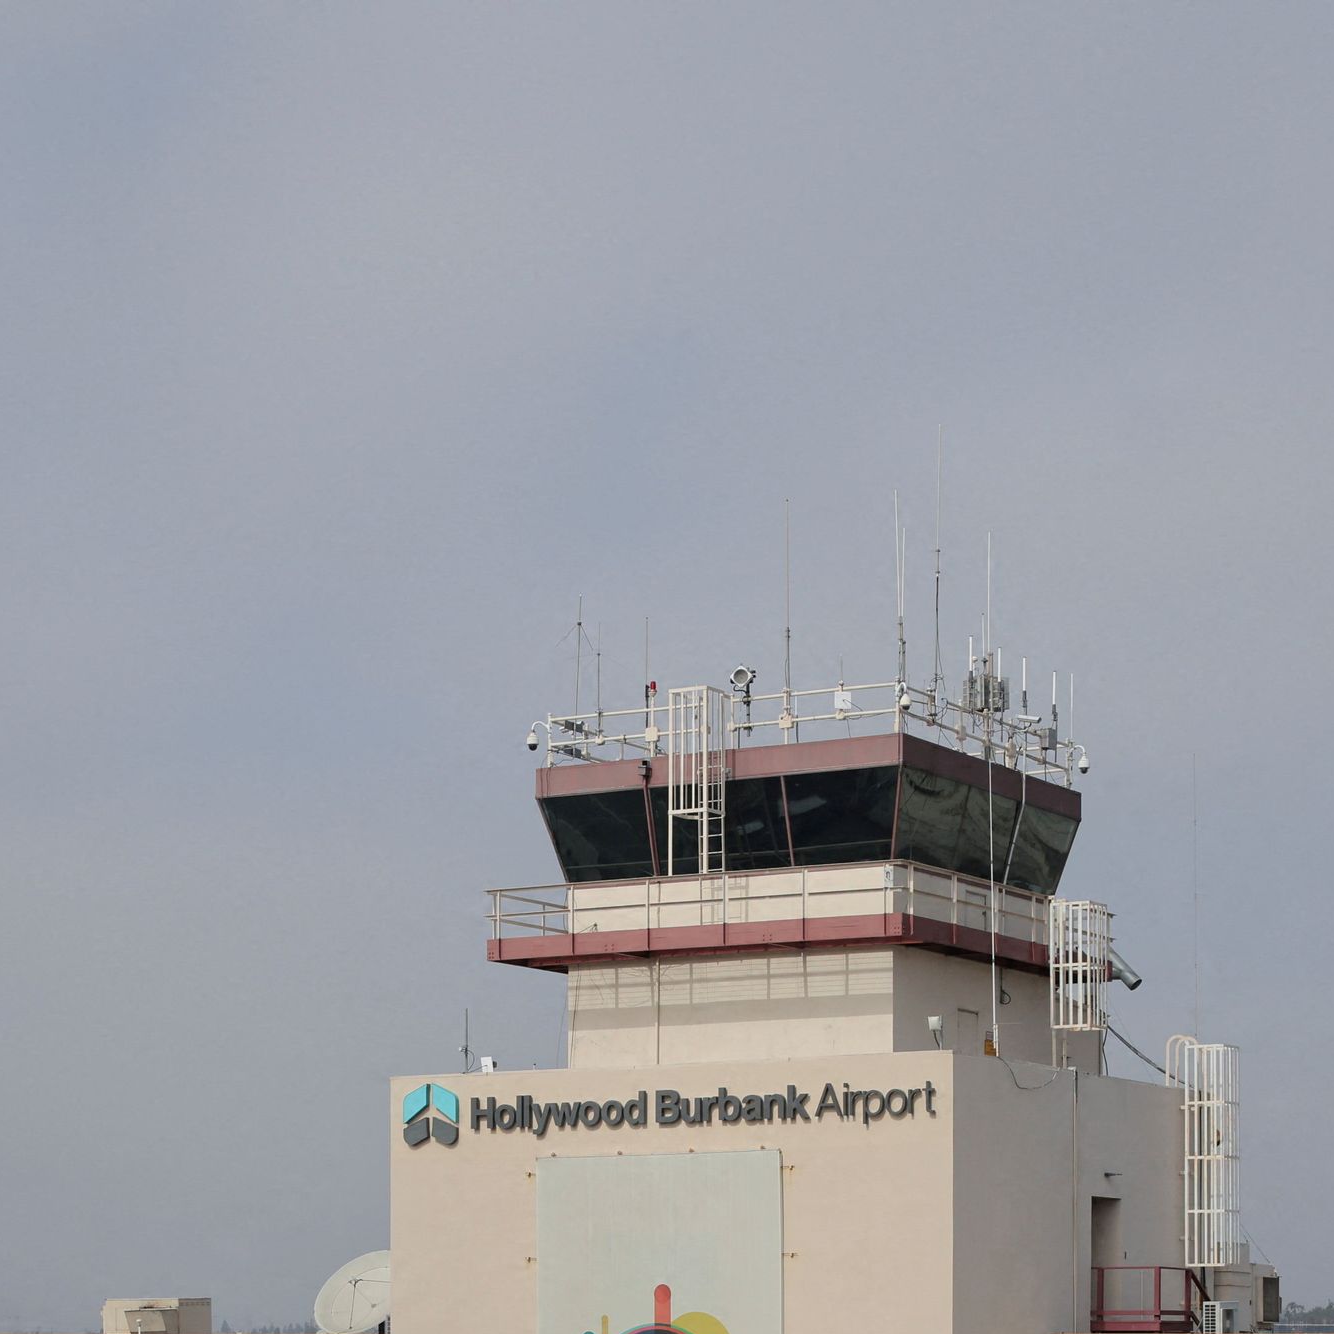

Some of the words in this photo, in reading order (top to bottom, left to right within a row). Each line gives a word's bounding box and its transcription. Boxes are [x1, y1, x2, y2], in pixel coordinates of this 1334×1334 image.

[470, 1090, 648, 1135] Hollywood
[654, 1085, 810, 1124] Burbank
[815, 1080, 936, 1127] Airport
